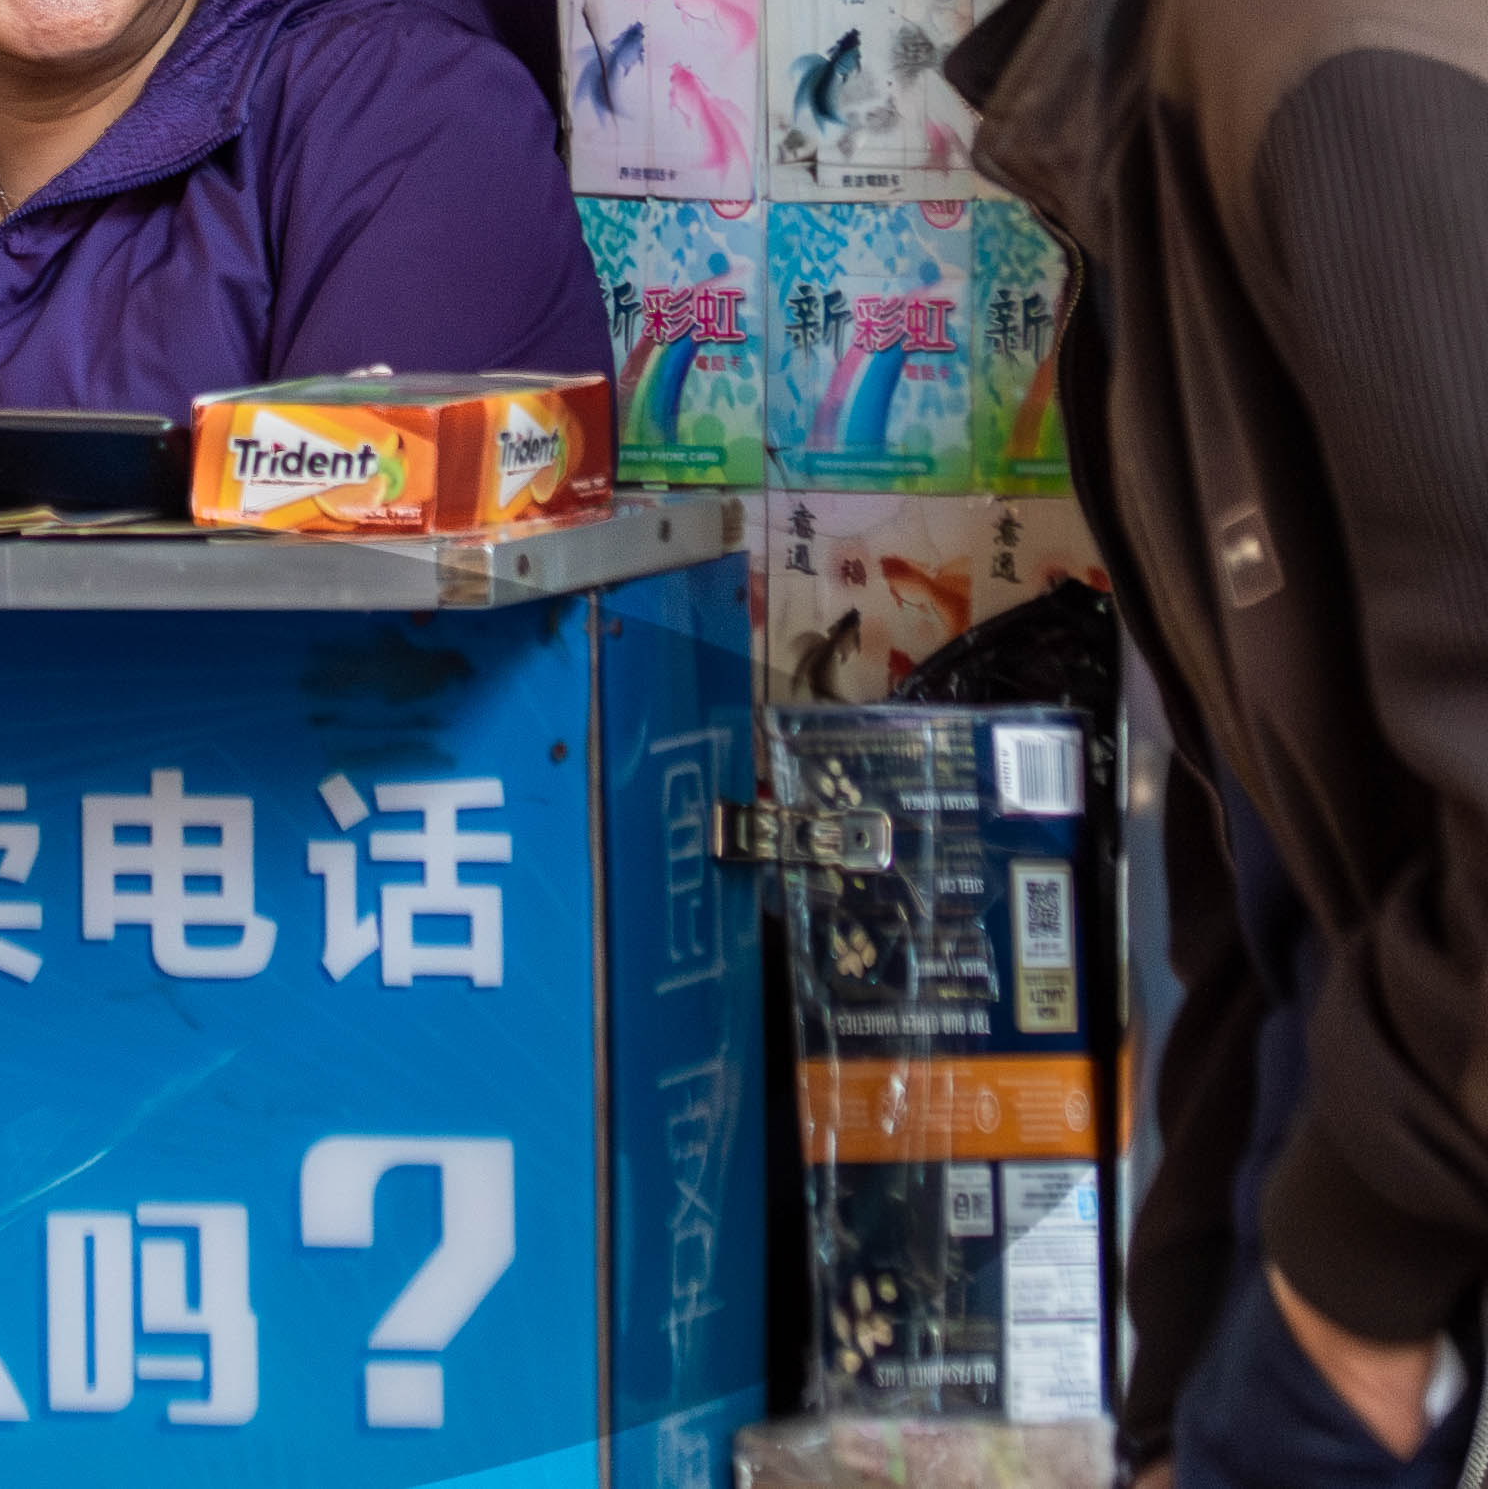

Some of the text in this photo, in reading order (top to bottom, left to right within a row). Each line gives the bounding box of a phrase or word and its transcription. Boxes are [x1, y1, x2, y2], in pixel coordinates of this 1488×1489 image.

[785, 284, 957, 366] 新彩虹
[985, 290, 1054, 364] 新
[233, 437, 375, 480] Trident
[498, 429, 561, 470] Trident
[840, 556, 868, 587] 福
[838, 1013, 991, 1035] TRY OUR OTHER VARIETIES
